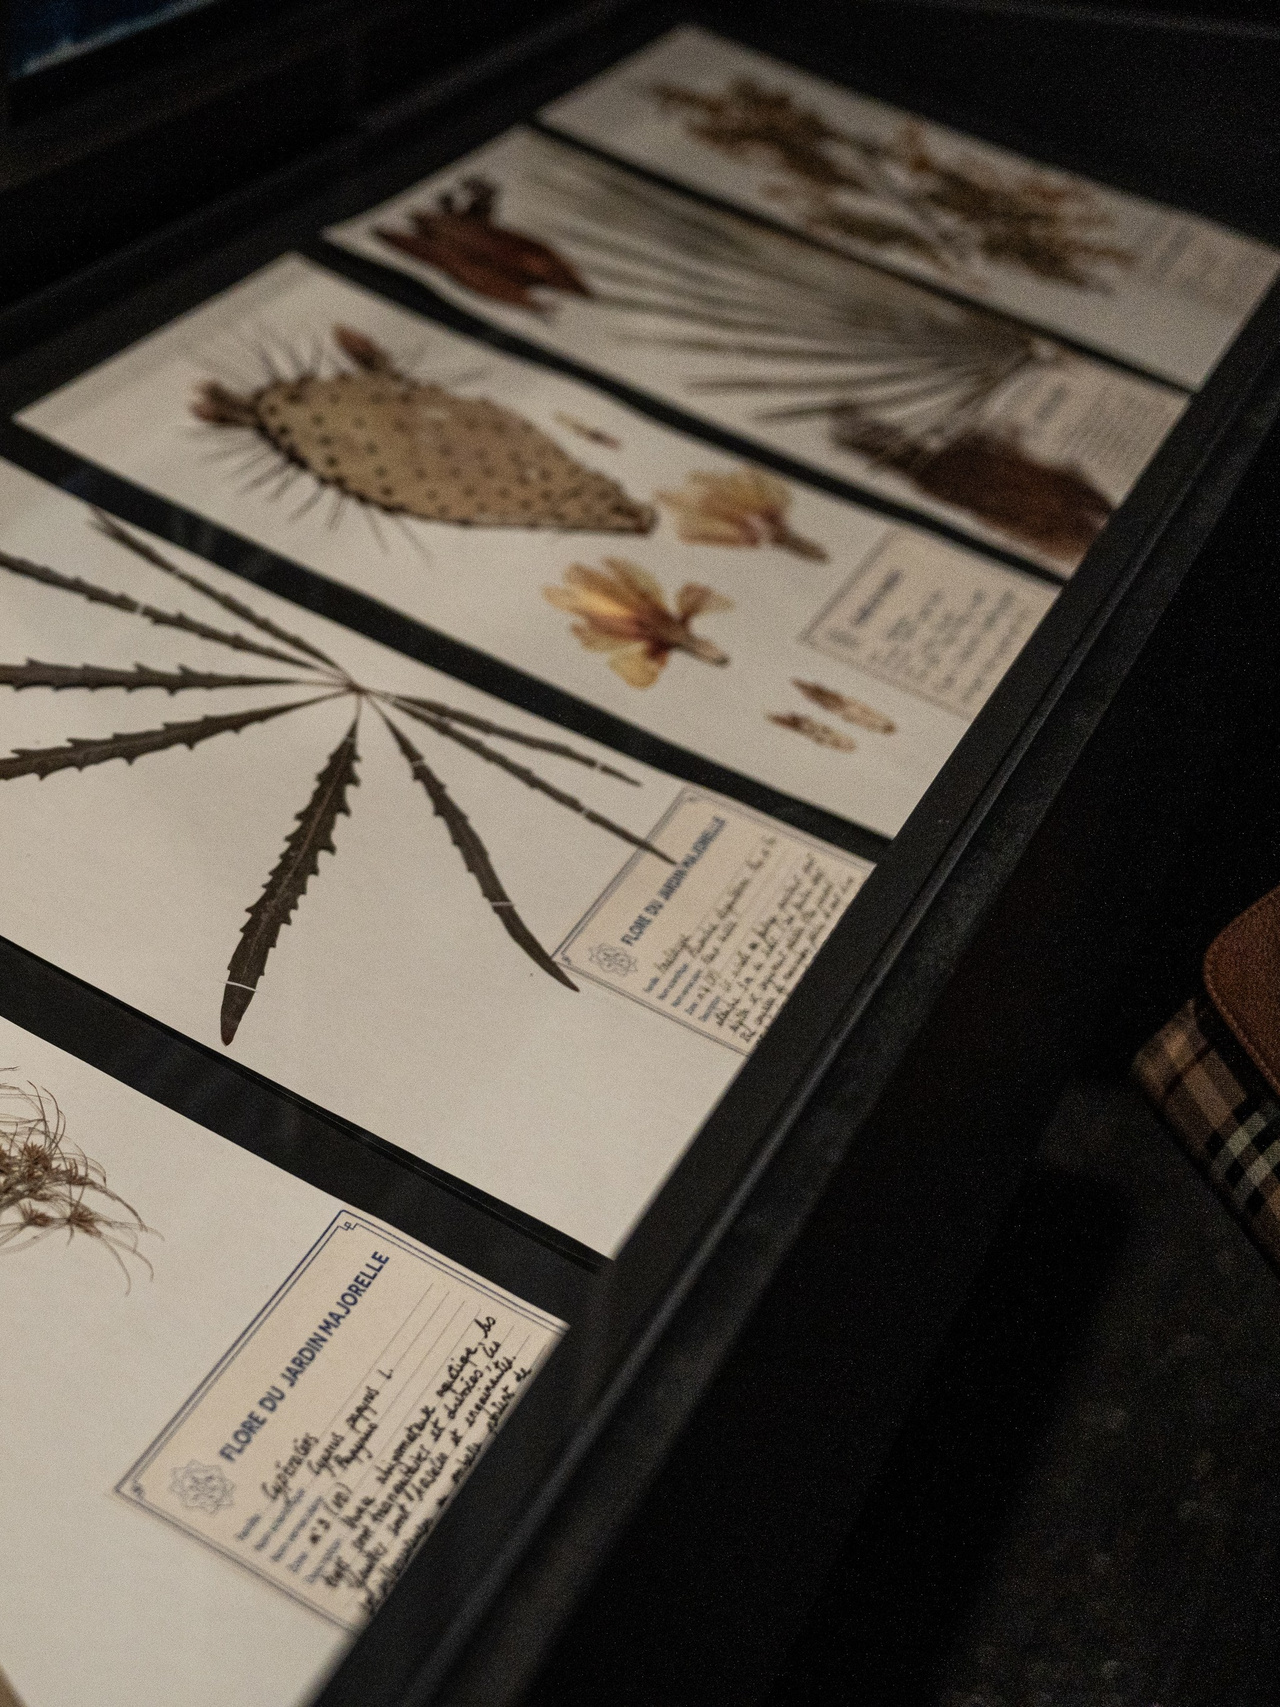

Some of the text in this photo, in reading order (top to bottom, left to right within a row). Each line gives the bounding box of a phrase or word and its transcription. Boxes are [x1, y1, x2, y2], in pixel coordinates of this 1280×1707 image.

[619, 913, 652, 946] FLORE
[218, 1410, 267, 1462] FLORE
[257, 1384, 286, 1413] DU
[280, 1331, 328, 1388] JARDIN
[317, 1250, 390, 1336] MAJORELLE
